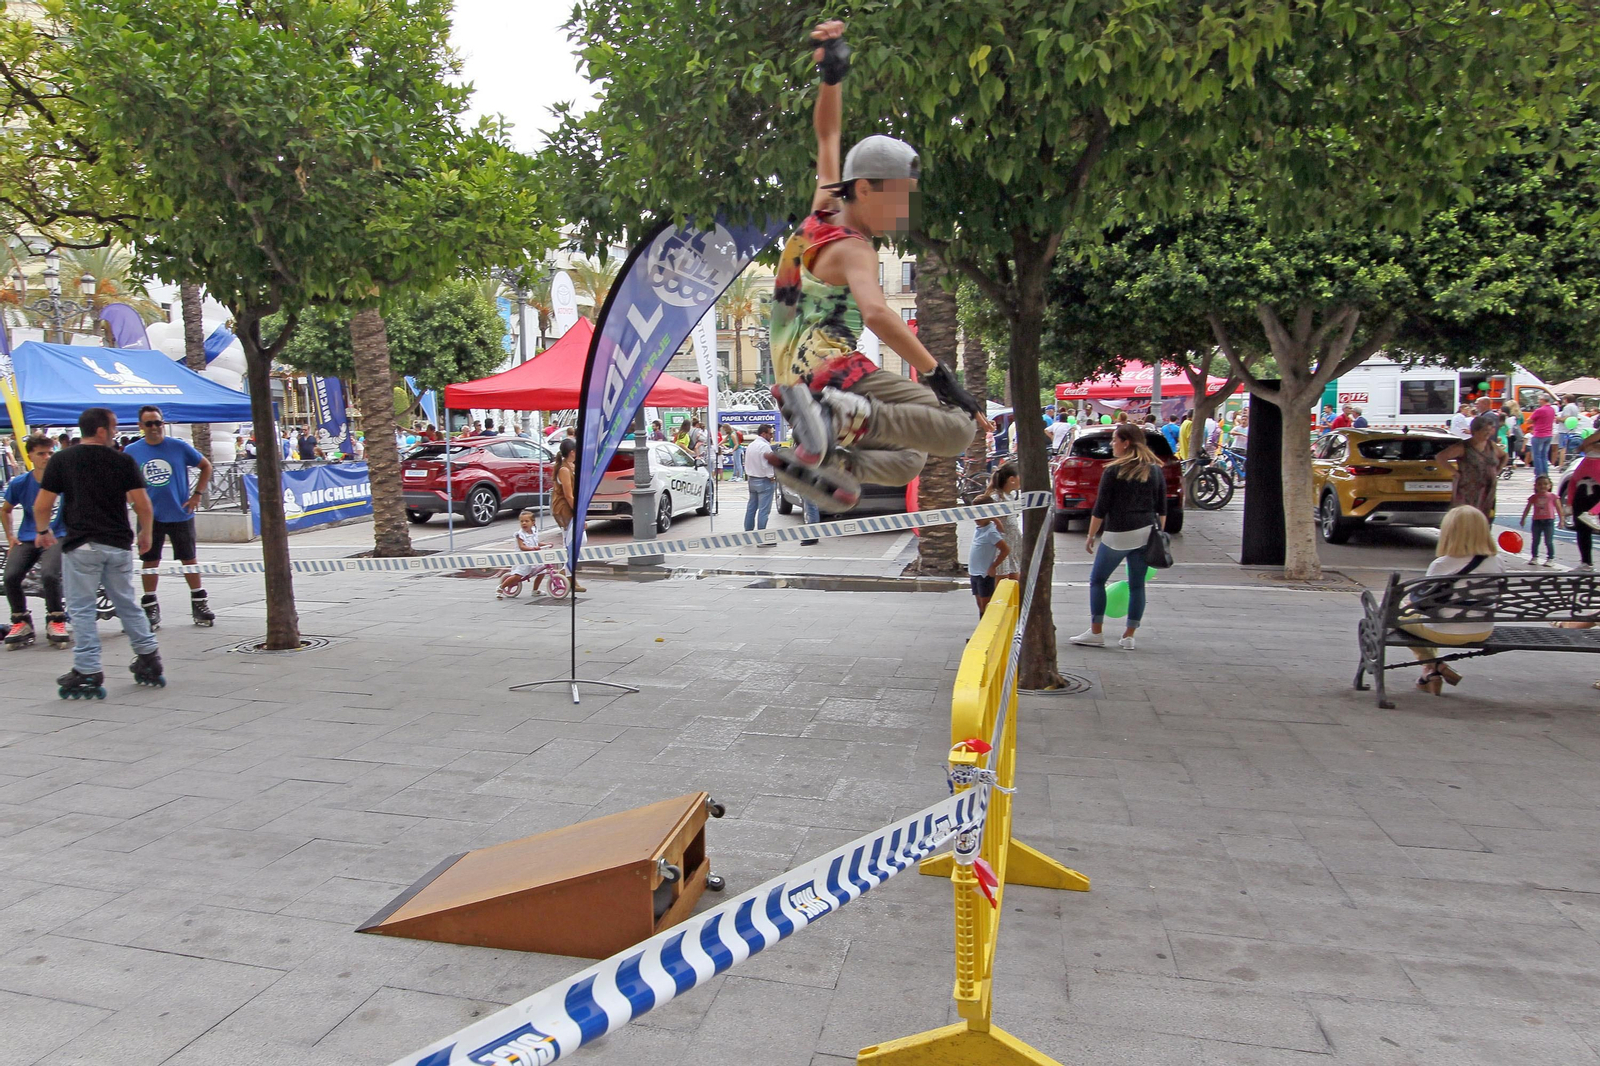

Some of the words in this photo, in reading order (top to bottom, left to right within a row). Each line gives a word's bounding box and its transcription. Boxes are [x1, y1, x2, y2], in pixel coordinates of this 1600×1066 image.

[95, 387, 184, 395] MICHELIN
[1350, 392, 1368, 401] 112
[749, 413, 776, 421] CARTÓN
[670, 478, 703, 497] COROLLA
